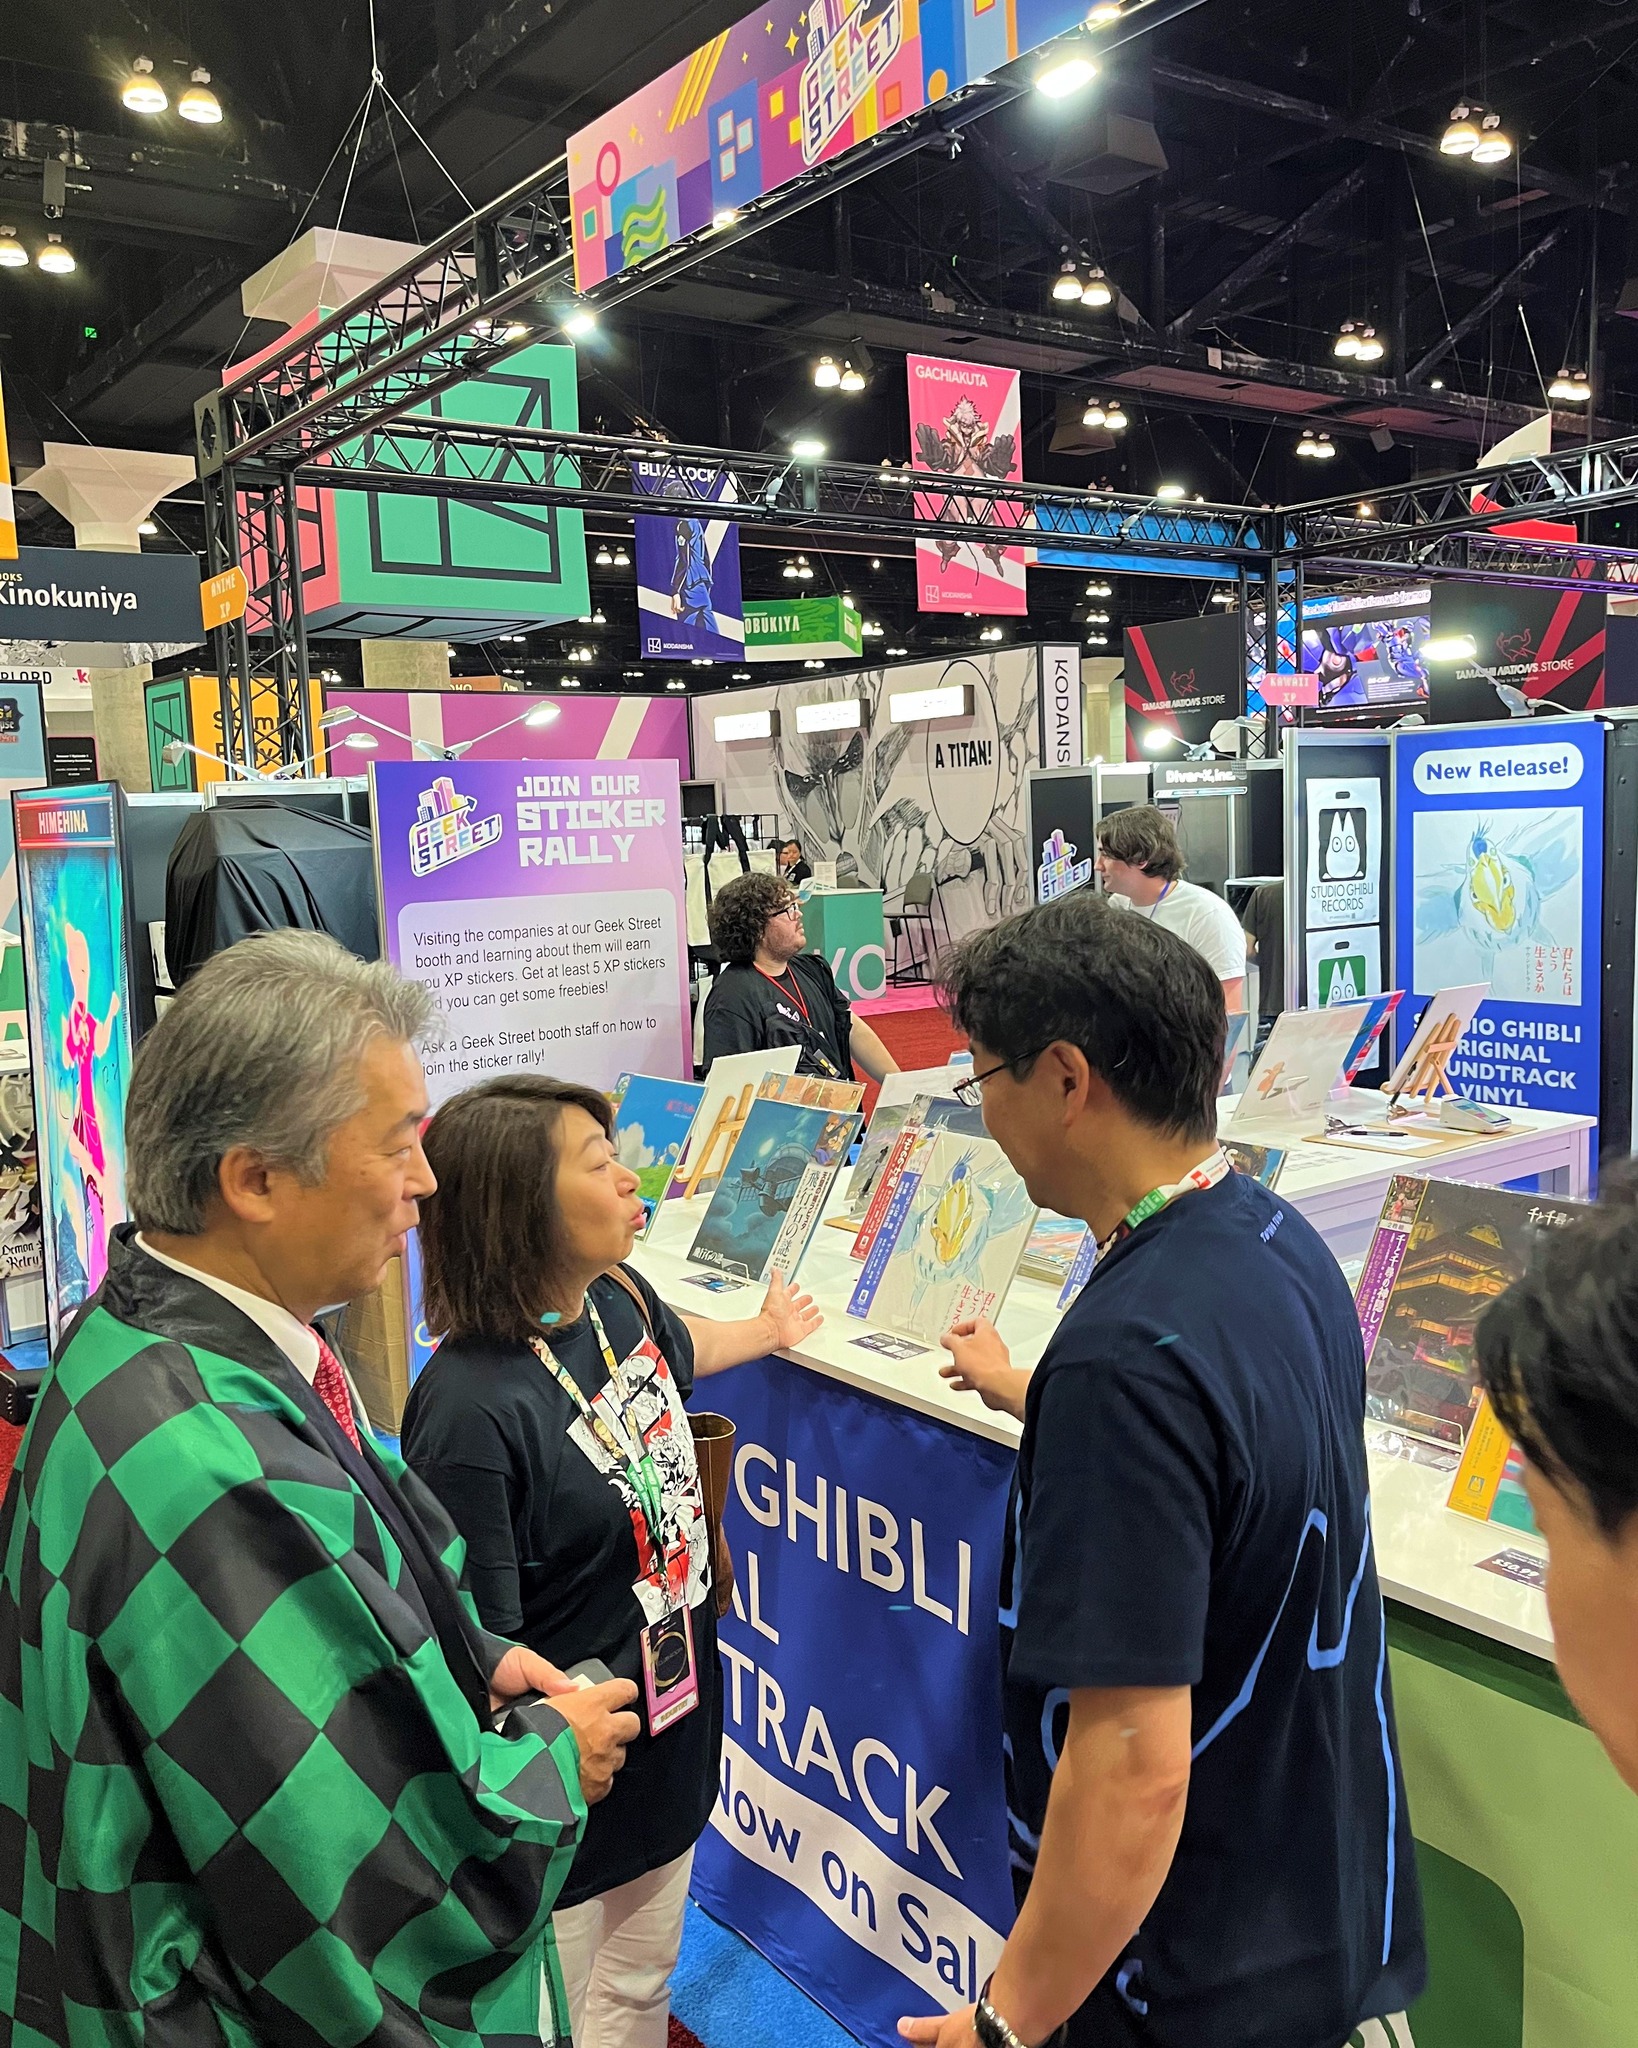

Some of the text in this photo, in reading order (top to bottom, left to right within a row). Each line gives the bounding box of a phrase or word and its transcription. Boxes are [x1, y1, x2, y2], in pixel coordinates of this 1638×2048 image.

[807, 10, 863, 113] GEEK
[809, 5, 895, 149] STREET
[915, 365, 988, 388] GACHIAKUTA
[678, 466, 716, 483] LOCK
[0, 581, 138, 615] Kinokuniya
[211, 573, 236, 597] ANIME
[219, 601, 231, 618] XP
[744, 616, 800, 634] OBUKIYA
[663, 643, 693, 651] KODANSHA
[1270, 676, 1309, 688] KAWAII
[1283, 692, 1296, 701] XP
[1054, 659, 1071, 767] KODANS
[935, 739, 992, 768] A TITAN!
[1427, 756, 1568, 780] New Release!
[516, 775, 640, 797] JOIN OUR
[38, 810, 88, 834] HIMEHINA
[416, 811, 469, 848] GEEK
[516, 799, 666, 831] STICKER
[419, 817, 496, 869] STREET
[519, 834, 635, 867] RALLY
[1041, 859, 1072, 886] GEEK
[1042, 862, 1088, 899] STREET
[1311, 882, 1374, 899] STUDIO GHIBLI
[1321, 897, 1364, 912] RECORDS
[413, 917, 661, 946] Visiting the companies at our Geek Street
[415, 939, 651, 968] booth and learning about them will earn
[1550, 946, 1560, 973] どう
[444, 972, 463, 987] XP
[467, 970, 517, 985] stickers.
[522, 966, 543, 980] Get
[547, 965, 558, 978] at
[562, 962, 590, 976] least
[593, 961, 600, 974] 5
[603, 959, 620, 973] XP
[624, 957, 666, 971] stickers
[1534, 946, 1547, 993] 生きるか
[1562, 947, 1574, 996] 君たちは
[446, 996, 469, 1012] you
[473, 993, 496, 1006] can
[500, 990, 519, 1007] get
[522, 988, 555, 1001] some
[559, 980, 608, 997] freebies!
[421, 1016, 656, 1055] Ask a Geek Street booth staff on how to
[1501, 1020, 1581, 1043] GHIBLI
[422, 1048, 545, 1079] join the sticker rally!
[1456, 1039, 1551, 1063] RIGINAL
[1446, 1060, 1577, 1089] UNDTRACK
[1460, 1083, 1529, 1106] VINYL
[777, 1170, 820, 1258] 飛行石の謎
[2, 1242, 34, 1256] Demon
[967, 1288, 984, 1316] どう
[734, 1442, 972, 1636] GHIBLI
[821, 1851, 878, 1932] on
[899, 1893, 977, 2004] Sal
